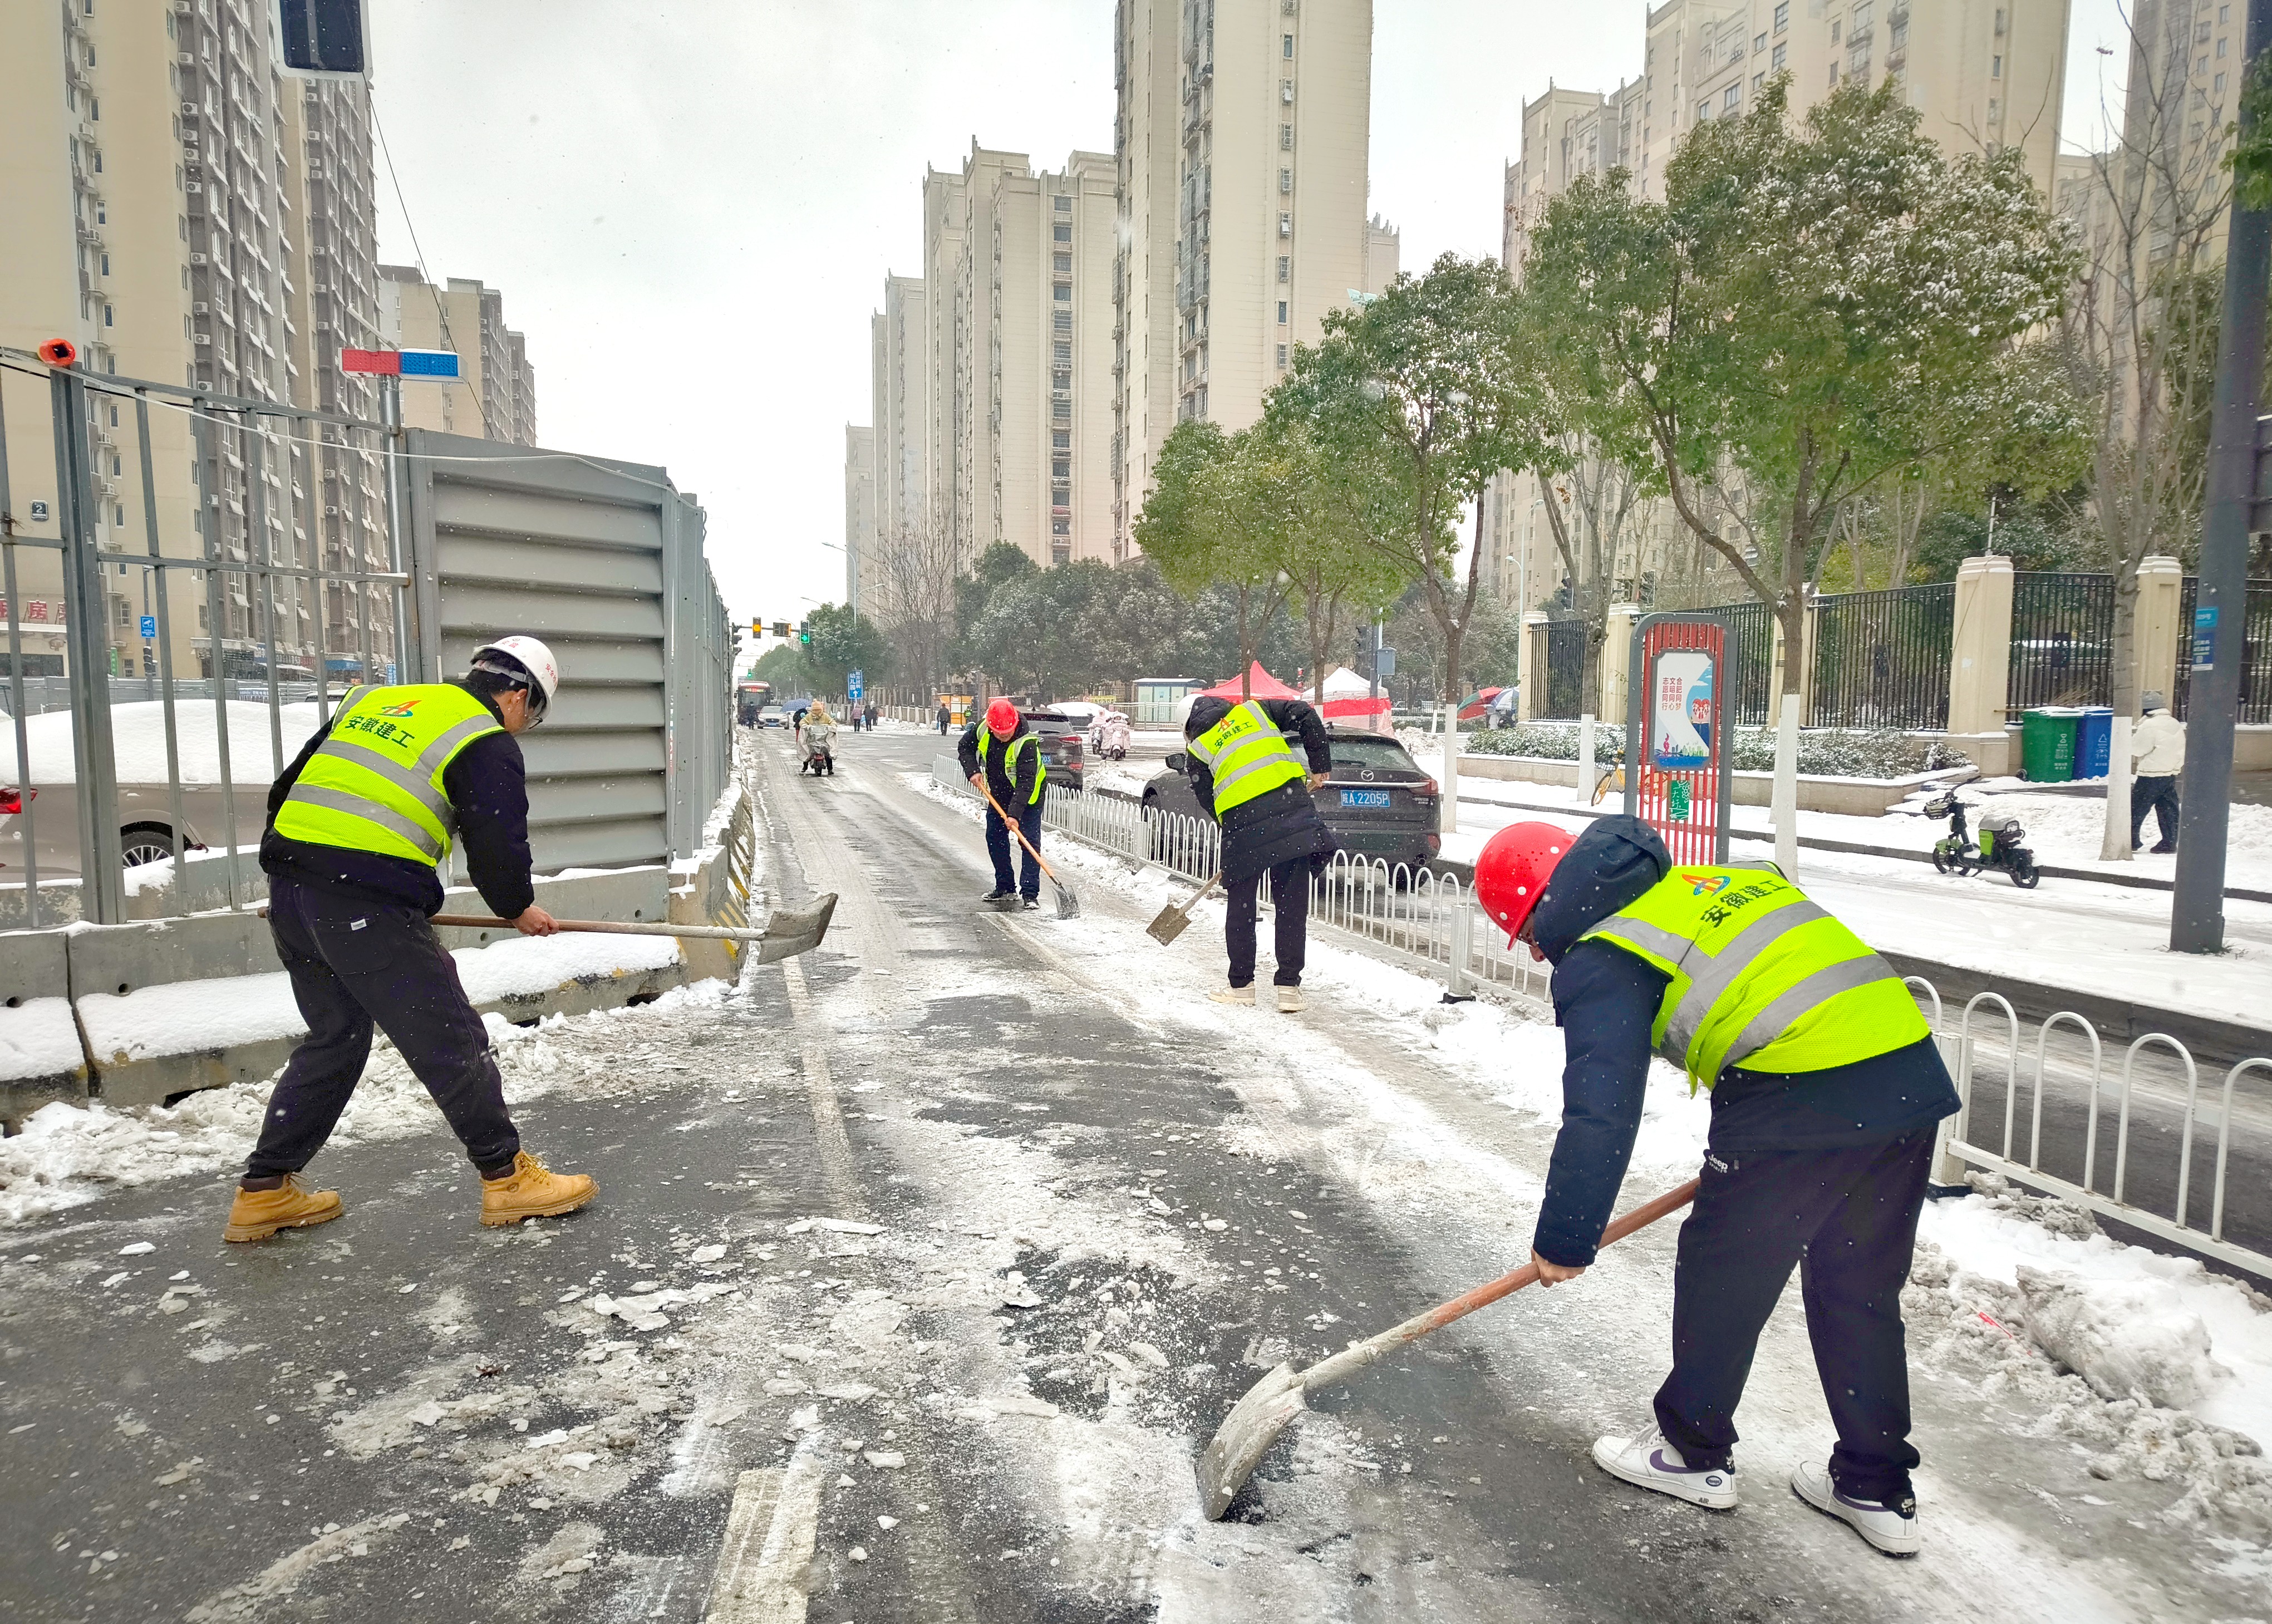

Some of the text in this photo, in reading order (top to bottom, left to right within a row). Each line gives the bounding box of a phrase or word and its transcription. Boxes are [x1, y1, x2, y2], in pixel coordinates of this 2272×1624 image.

[345, 715, 415, 749] 安徽建工
[1214, 721, 1253, 749] 安徽建工
[1700, 880, 1789, 928] 安徽建工
[1708, 1154, 1728, 1170] Jeep
